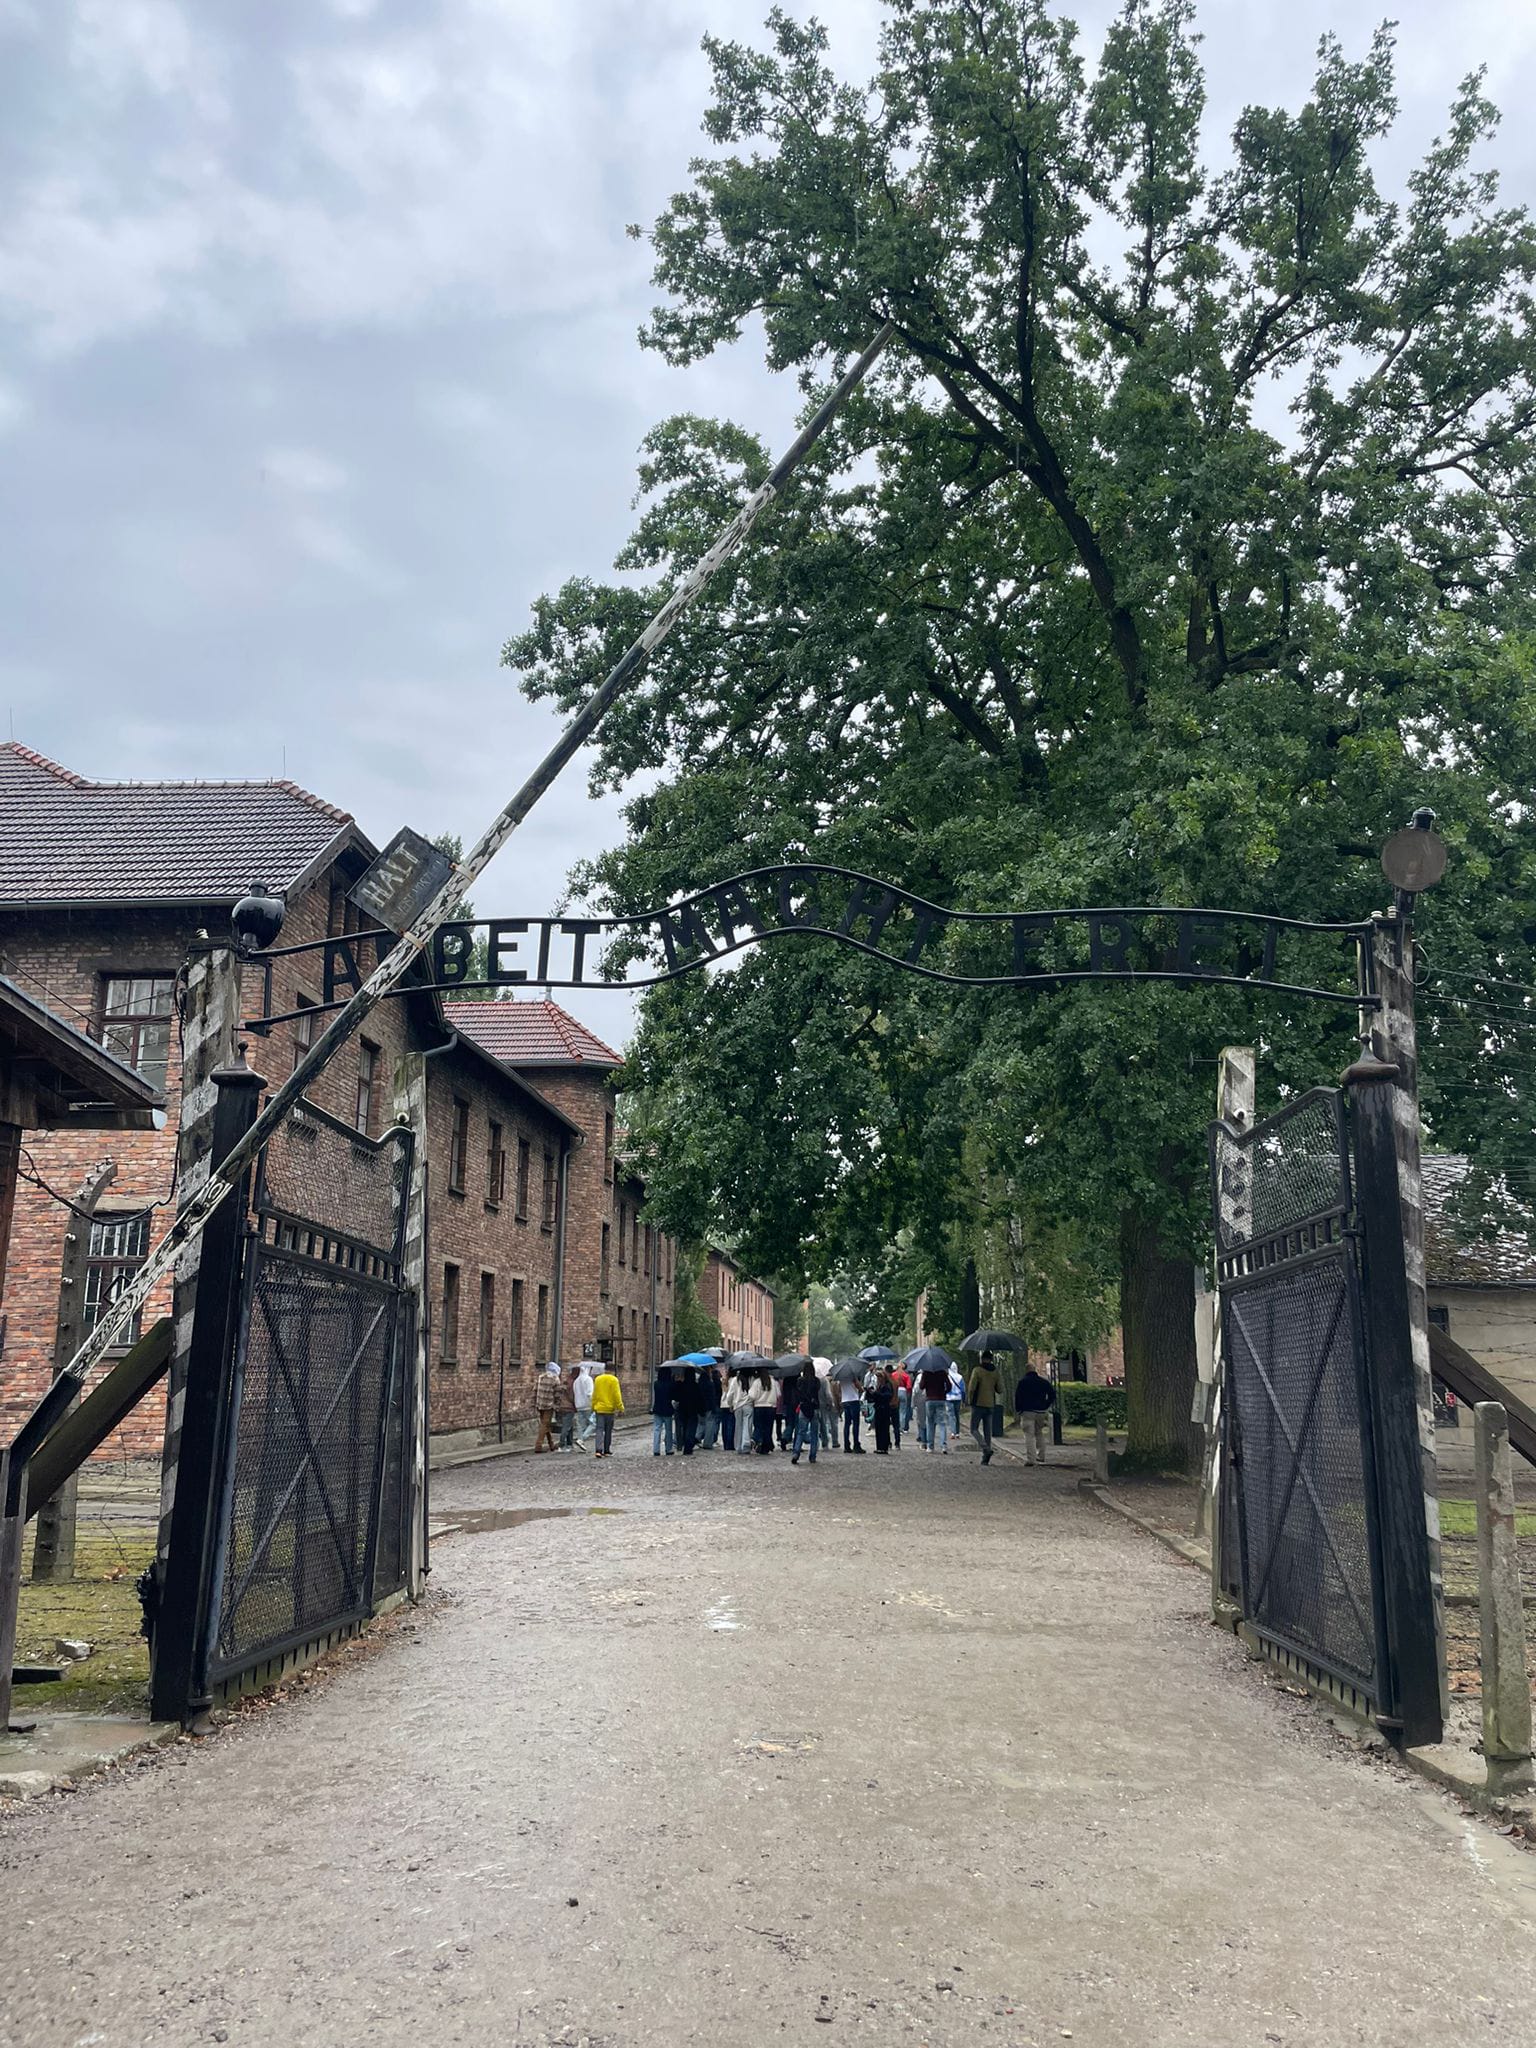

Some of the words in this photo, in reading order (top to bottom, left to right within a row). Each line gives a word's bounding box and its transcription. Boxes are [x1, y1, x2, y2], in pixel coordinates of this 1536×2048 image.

[361, 842, 419, 908] HALT
[657, 868, 950, 971] MACHT
[1012, 912, 1279, 981] FREI
